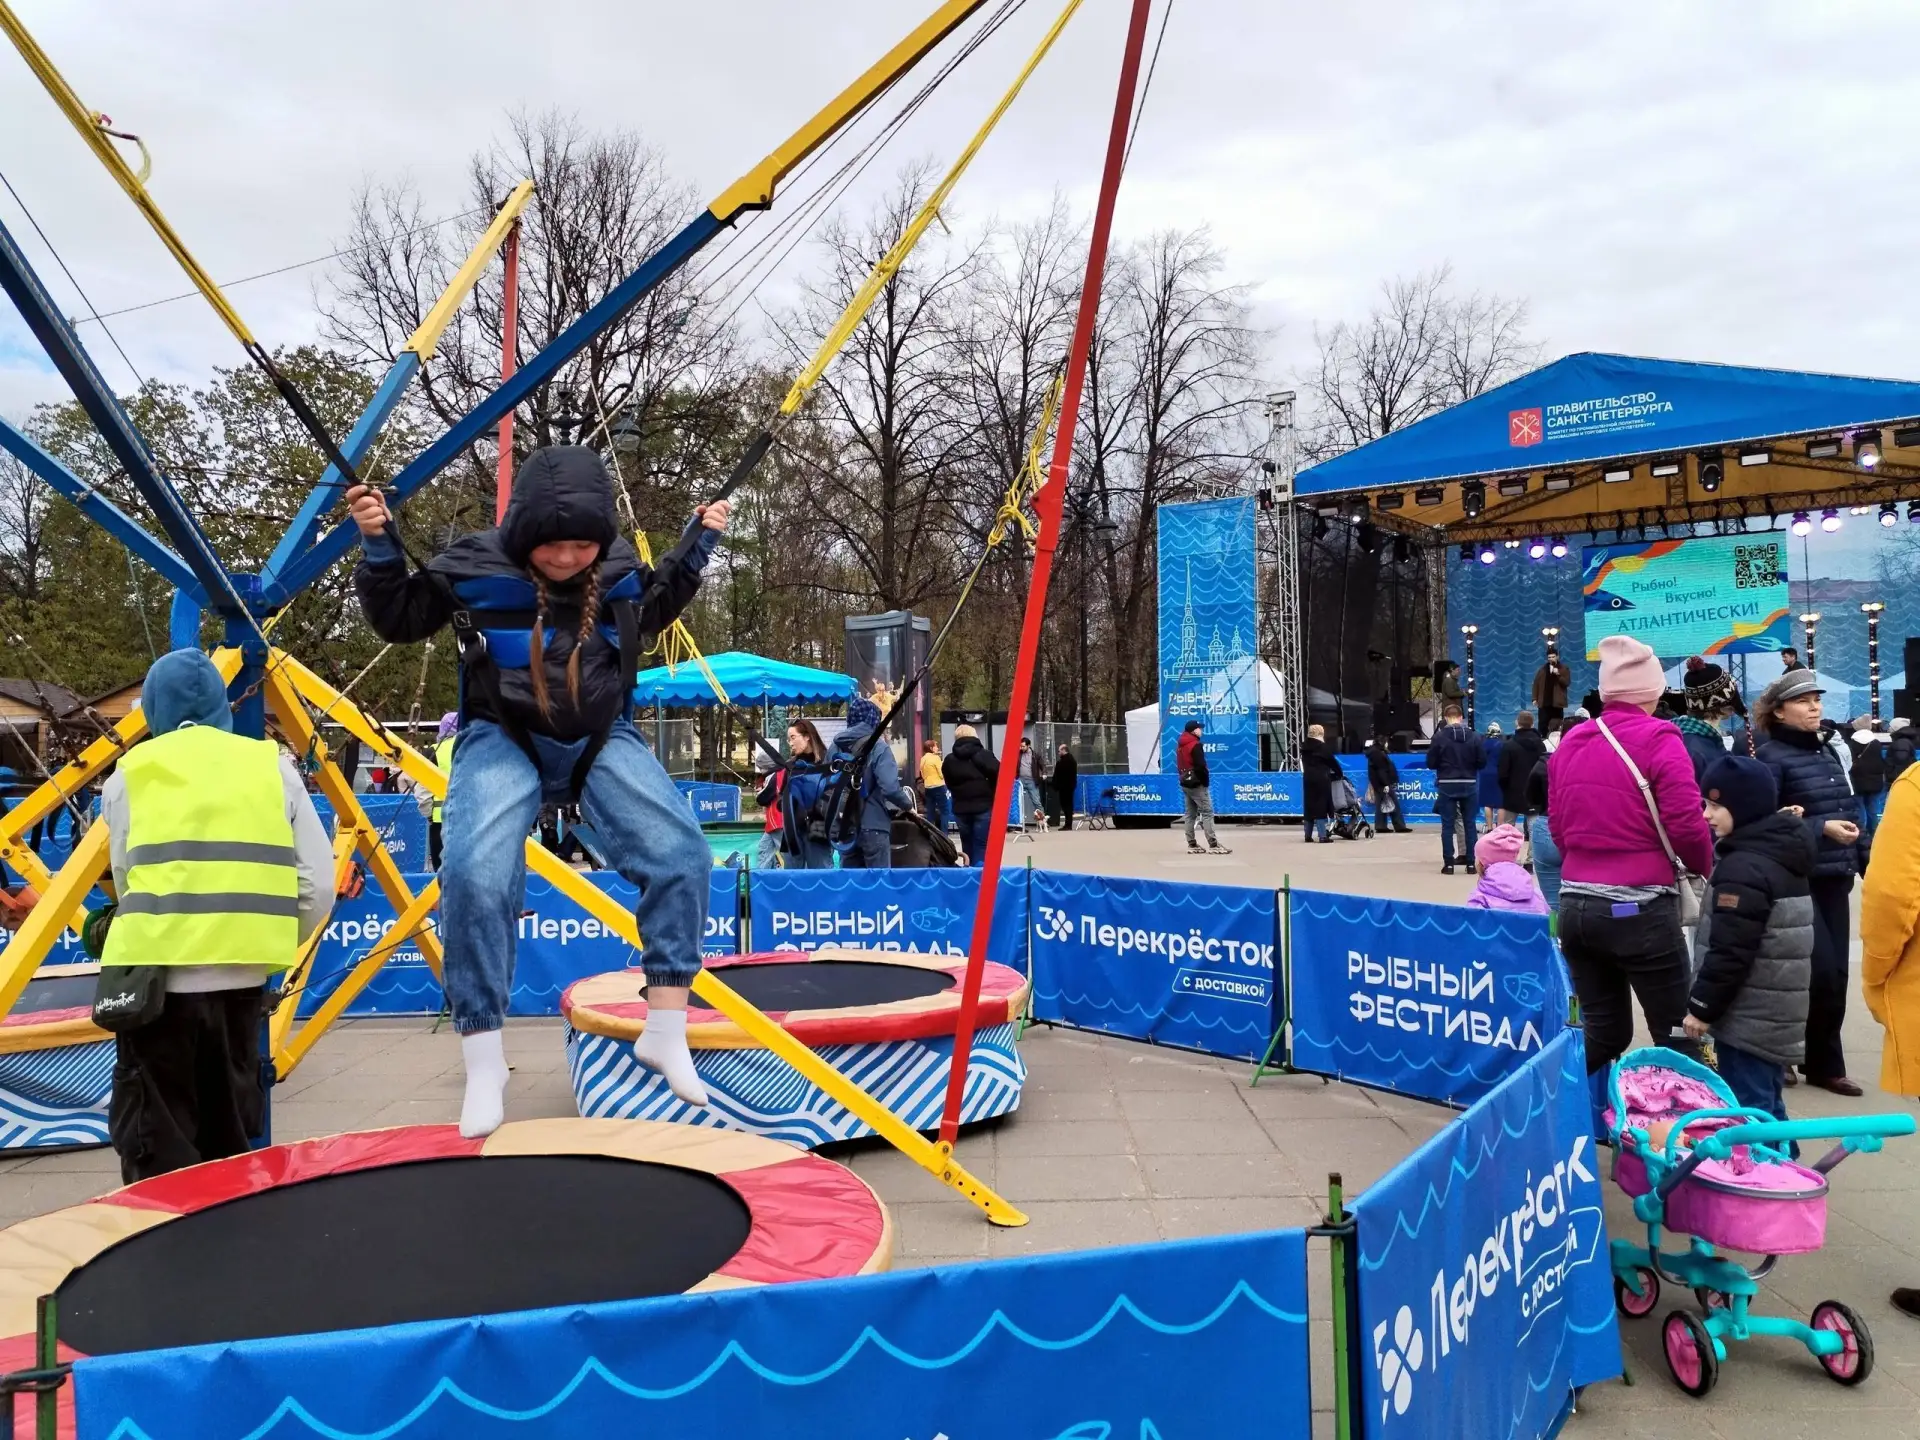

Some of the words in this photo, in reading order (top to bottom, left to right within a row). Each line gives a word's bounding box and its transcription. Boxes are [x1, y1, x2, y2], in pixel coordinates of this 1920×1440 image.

[1547, 391, 1656, 417] ПРАВИТЕЛЬСТВО
[1547, 401, 1673, 428] САНКТ-ПЕТЕРБУРГА
[1632, 576, 1677, 593] Рыбно!
[1665, 586, 1717, 605] Вкусно!
[1618, 602, 1760, 632] АТЛАНТИЧЕСКИ!
[1169, 704, 1250, 716] ФЕСТИВАЛЬ
[1233, 783, 1273, 792] РЫБНЫЙ
[1234, 793, 1290, 801] ФЕСТИВАЛЬ
[772, 903, 904, 935] РЫБНЫЙ
[1081, 914, 1275, 969] Перекрёсток
[1182, 975, 1191, 988] с
[1195, 976, 1265, 999] доставкой
[1348, 950, 1495, 1004] РЫБНЫЙ
[1349, 990, 1544, 1052] ФЕСТИВАЛ
